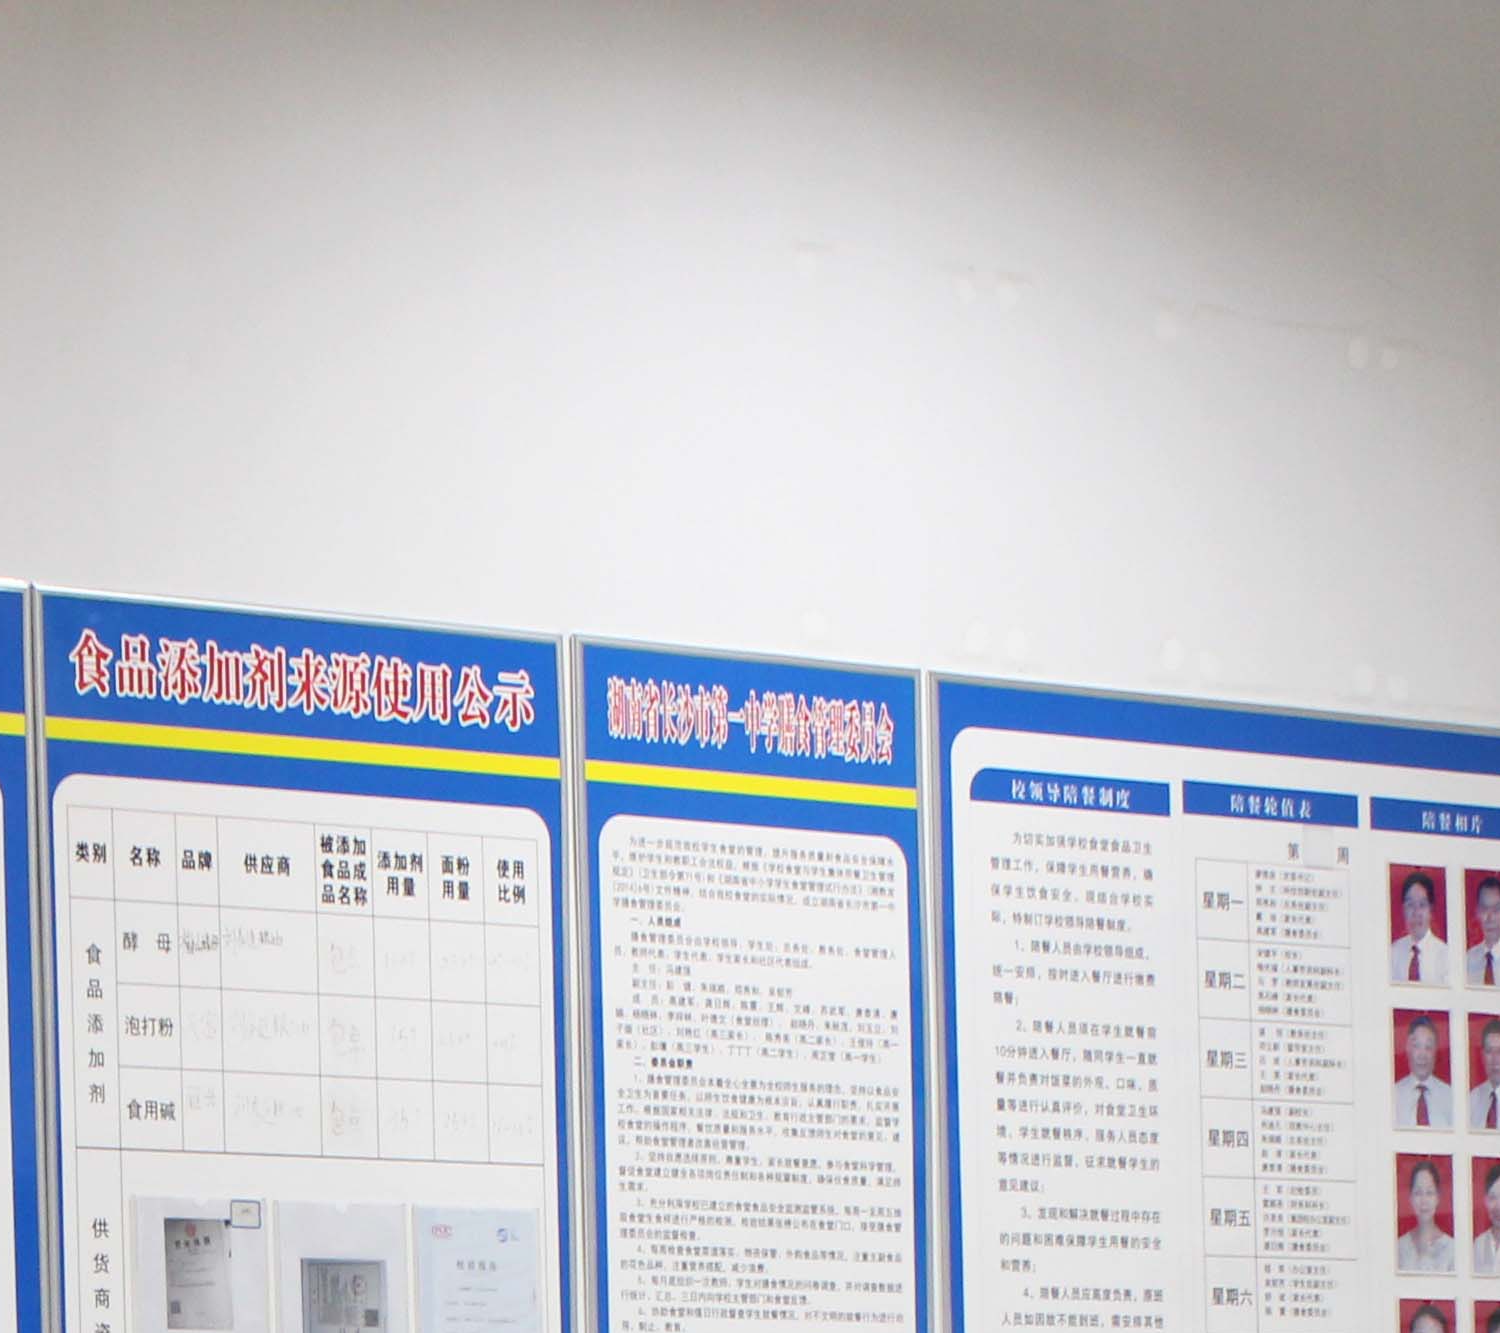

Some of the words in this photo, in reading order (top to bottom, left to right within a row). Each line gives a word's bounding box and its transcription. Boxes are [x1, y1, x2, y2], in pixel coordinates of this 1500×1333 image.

[70, 629, 535, 730] 食品添加剂来源使用公示
[608, 675, 894, 765] 湖南省长沙市第一中学膳食管理委员会
[1012, 778, 1130, 809] 校领导陪餐制度
[1231, 793, 1312, 819] 陪餐轮值表
[75, 841, 107, 865] 类别
[320, 834, 367, 856] 被添加
[1288, 842, 1299, 860] 第
[1337, 846, 1349, 865] 周
[129, 845, 162, 869] 名称
[181, 850, 213, 872] 品牌
[244, 853, 291, 877] 供应商
[377, 851, 423, 873] 添加剂
[440, 855, 470, 877] 面粉
[321, 857, 367, 882] 食品成
[496, 858, 525, 880] 使用
[321, 883, 368, 907] 品名称
[386, 876, 415, 898] 用量
[442, 879, 470, 902] 用量
[498, 883, 526, 905] 比例
[1202, 891, 1244, 911] 星期一
[1204, 970, 1246, 990] 星期二
[85, 943, 105, 1105] 食品添加剂
[124, 1016, 174, 1038] 泡打粉
[1207, 1049, 1248, 1069] 星期三
[127, 1099, 176, 1123] 食用碱
[1208, 1128, 1249, 1148] 星期四
[1210, 1208, 1251, 1227] 星期五
[1212, 1287, 1253, 1306] 星期六
